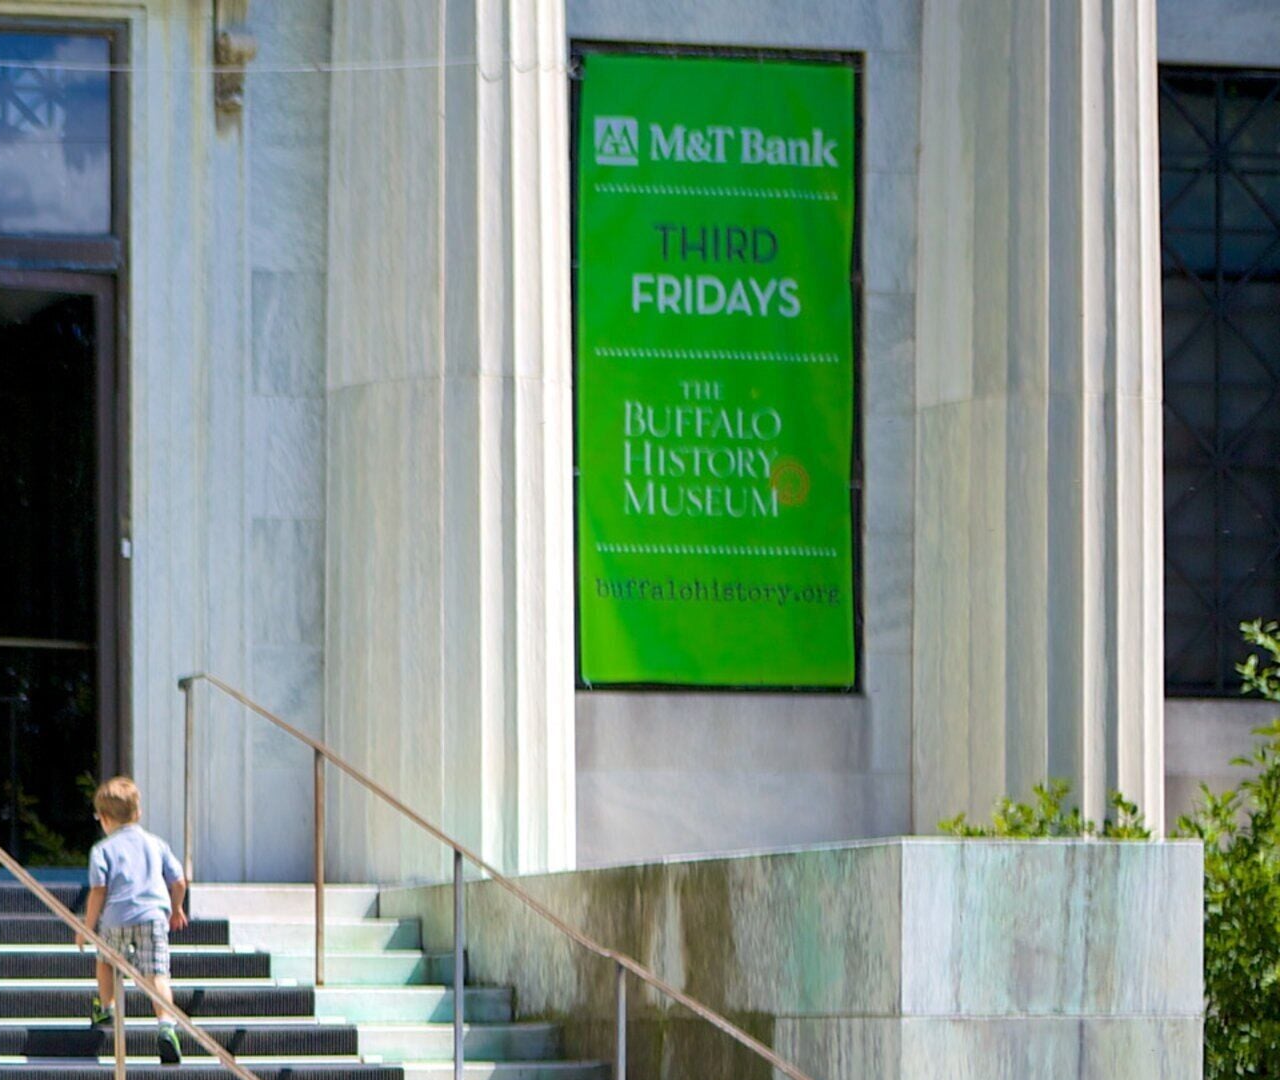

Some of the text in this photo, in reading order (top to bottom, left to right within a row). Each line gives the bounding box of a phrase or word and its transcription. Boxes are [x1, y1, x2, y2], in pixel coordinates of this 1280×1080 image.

[649, 122, 839, 168] M&T Bank
[653, 221, 779, 264] THIRD
[631, 272, 802, 318] FRIDAYS
[624, 399, 783, 441] BUFFALO
[624, 439, 779, 479] HISTORY
[624, 478, 779, 518] MUSEUM
[595, 577, 840, 607] buffalohistory.org
